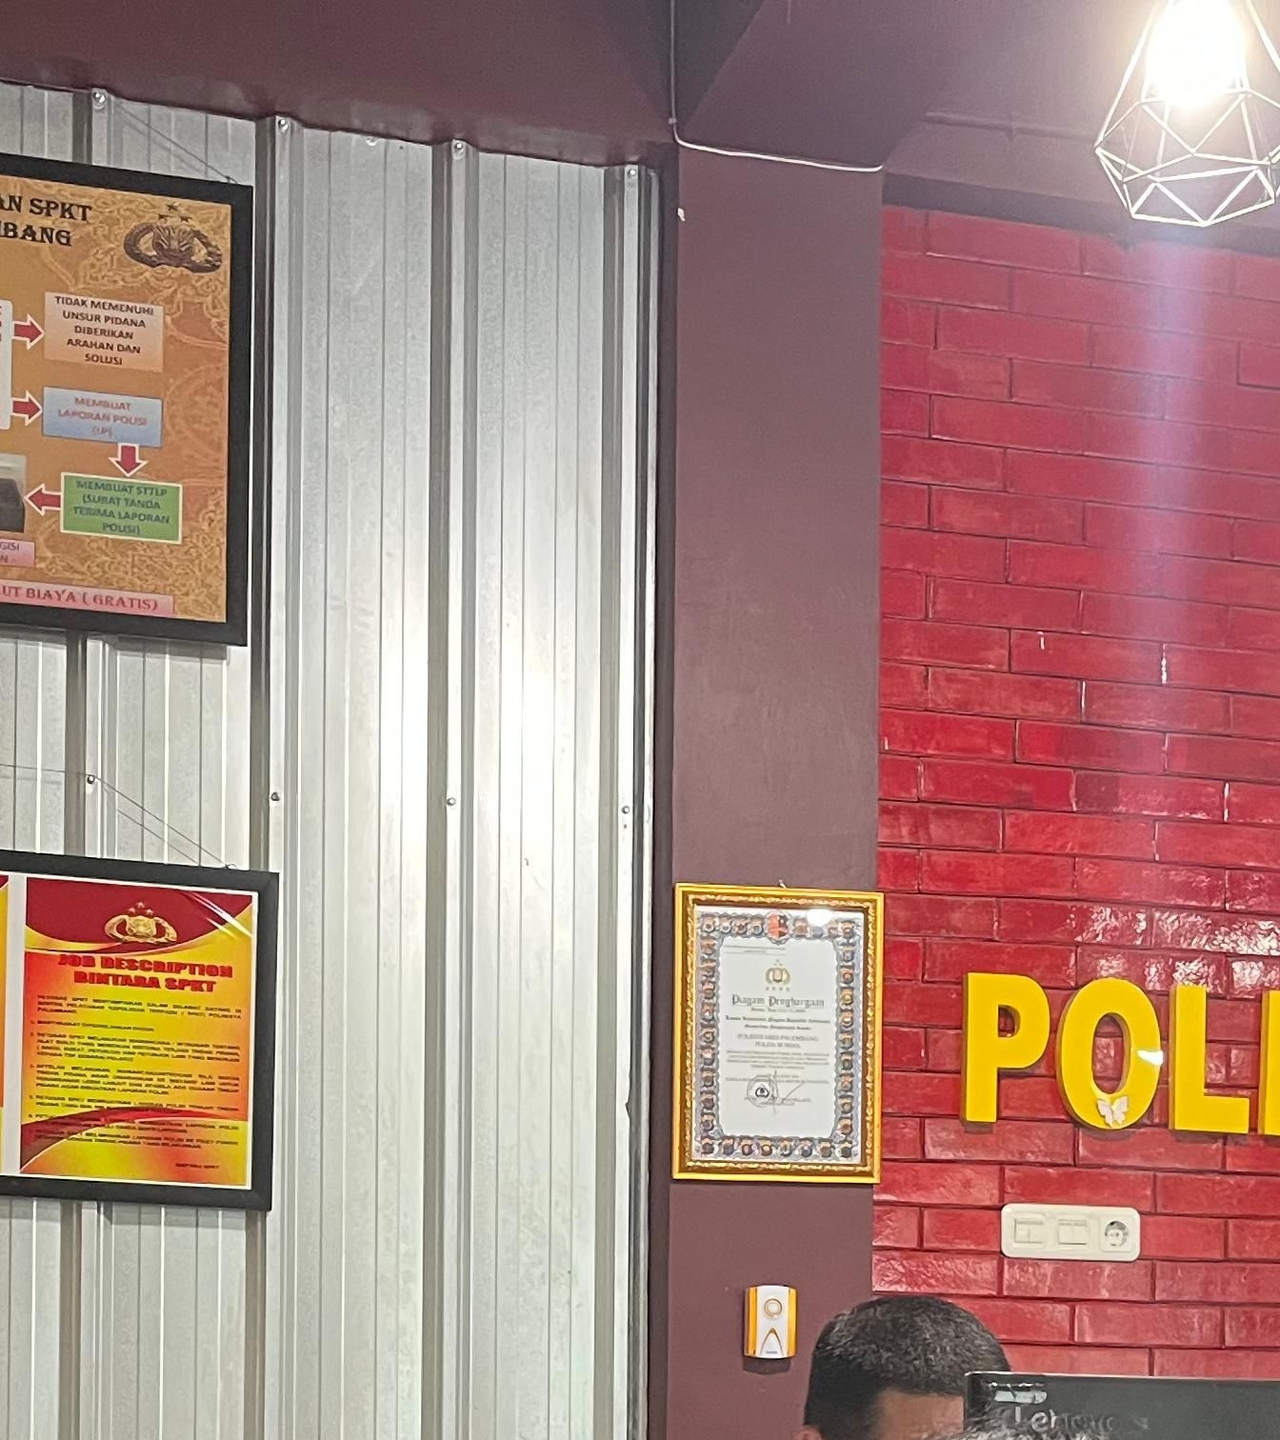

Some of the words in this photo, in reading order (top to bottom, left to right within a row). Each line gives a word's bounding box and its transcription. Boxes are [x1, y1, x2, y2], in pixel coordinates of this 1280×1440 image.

[28, 197, 93, 222] SPKT
[54, 295, 88, 308] TIDAK
[90, 300, 154, 316] MEMENUHI
[62, 310, 101, 323] UNSUR
[104, 315, 147, 329] PIDANA
[74, 325, 134, 340] DIBERIKAN
[66, 338, 114, 352] ARAHAN
[116, 343, 141, 355] DAN
[84, 353, 123, 366] SOLUSI
[74, 397, 132, 411] MEMBUAT
[57, 409, 111, 422] LAPORAN
[113, 413, 148, 426] POLISI
[76, 480, 134, 493] MEMBUAT
[82, 493, 121, 506] (SURAT
[123, 497, 162, 510] TANDA
[73, 506, 116, 519] TERIMA
[117, 510, 170, 524] LAPORAN
[25, 587, 76, 603] BIAYA
[57, 953, 97, 968] JOB
[100, 956, 233, 979] DESCRIPTION
[73, 970, 161, 990] BINTARA
[164, 976, 217, 993] SPKT
